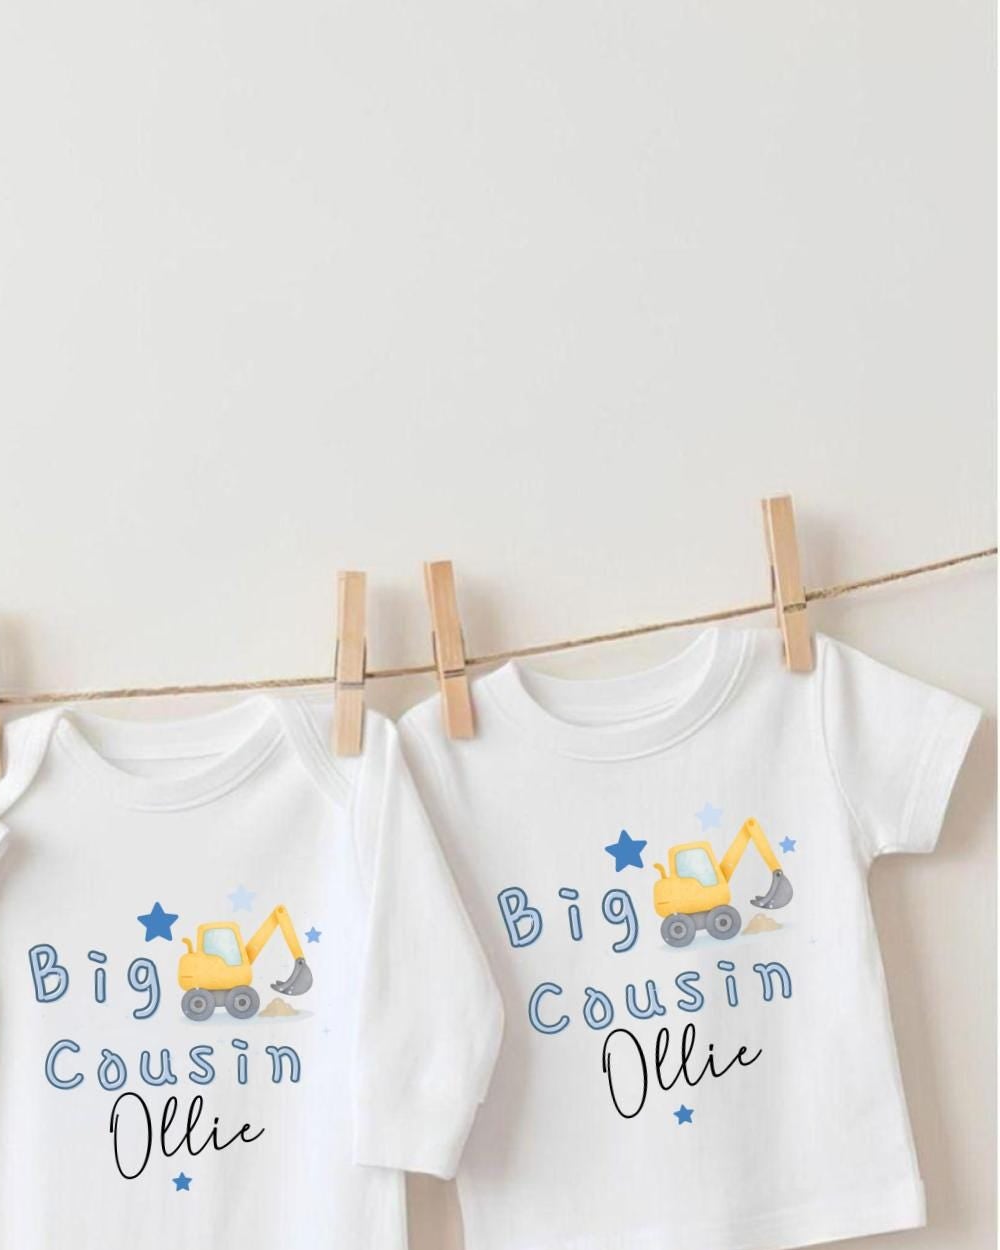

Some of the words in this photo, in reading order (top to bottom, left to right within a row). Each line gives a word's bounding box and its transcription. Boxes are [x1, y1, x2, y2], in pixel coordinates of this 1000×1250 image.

[498, 887, 638, 952] Big
[30, 945, 160, 1019] Big
[529, 961, 792, 1034] Cousin
[46, 1040, 300, 1090] Cousin
[603, 1024, 762, 1118] Ollie
[110, 1092, 264, 1179] Ollie
